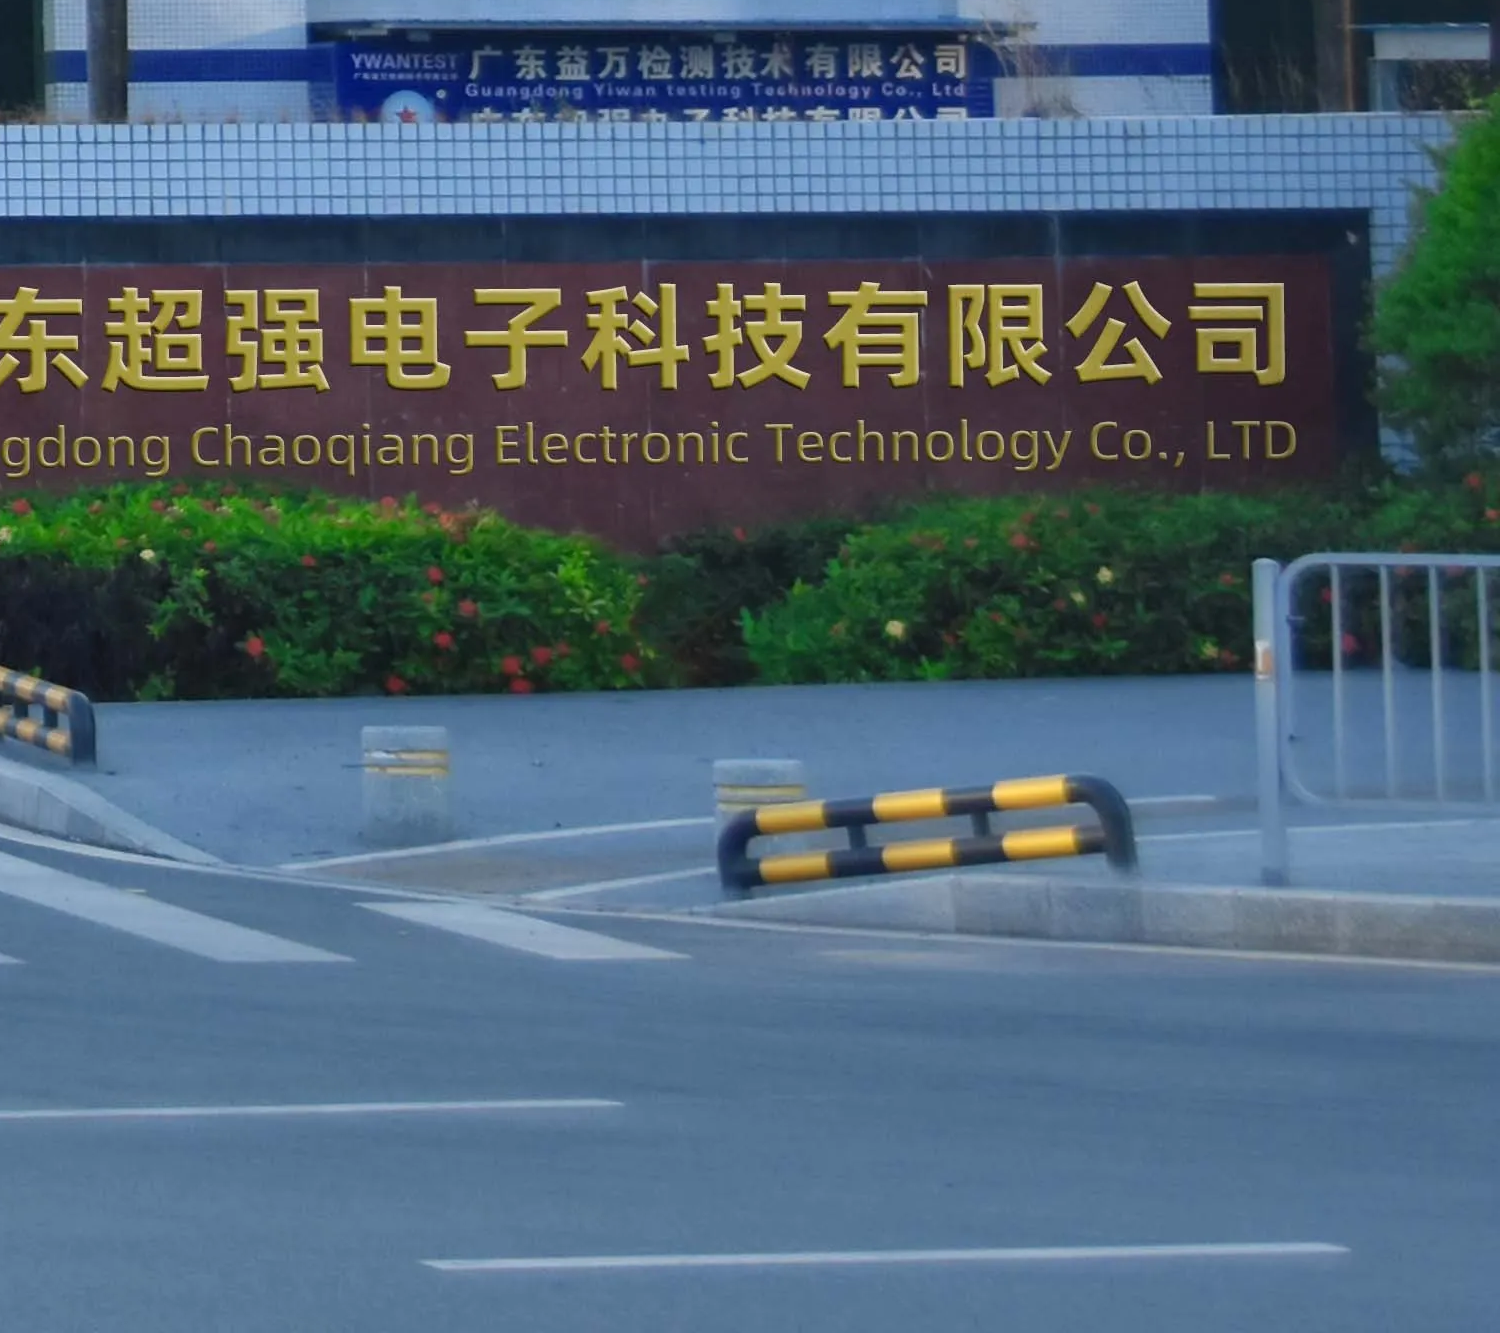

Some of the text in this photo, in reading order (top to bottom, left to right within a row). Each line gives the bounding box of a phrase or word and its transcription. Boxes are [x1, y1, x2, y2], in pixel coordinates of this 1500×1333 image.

[350, 53, 458, 70] YWANTEST
[468, 44, 968, 81] 广东益万检测技术有限公司
[465, 83, 584, 100] Guangdong
[593, 83, 658, 98] Yiwan
[667, 83, 742, 99] testing
[752, 82, 872, 99] Technology
[932, 83, 966, 98] Ltd
[190, 424, 476, 477] Chaoqiang
[495, 422, 748, 467] Electronic
[766, 420, 1072, 472] Technology
[1090, 421, 1185, 469] Co.,
[1207, 420, 1297, 463] LTD
